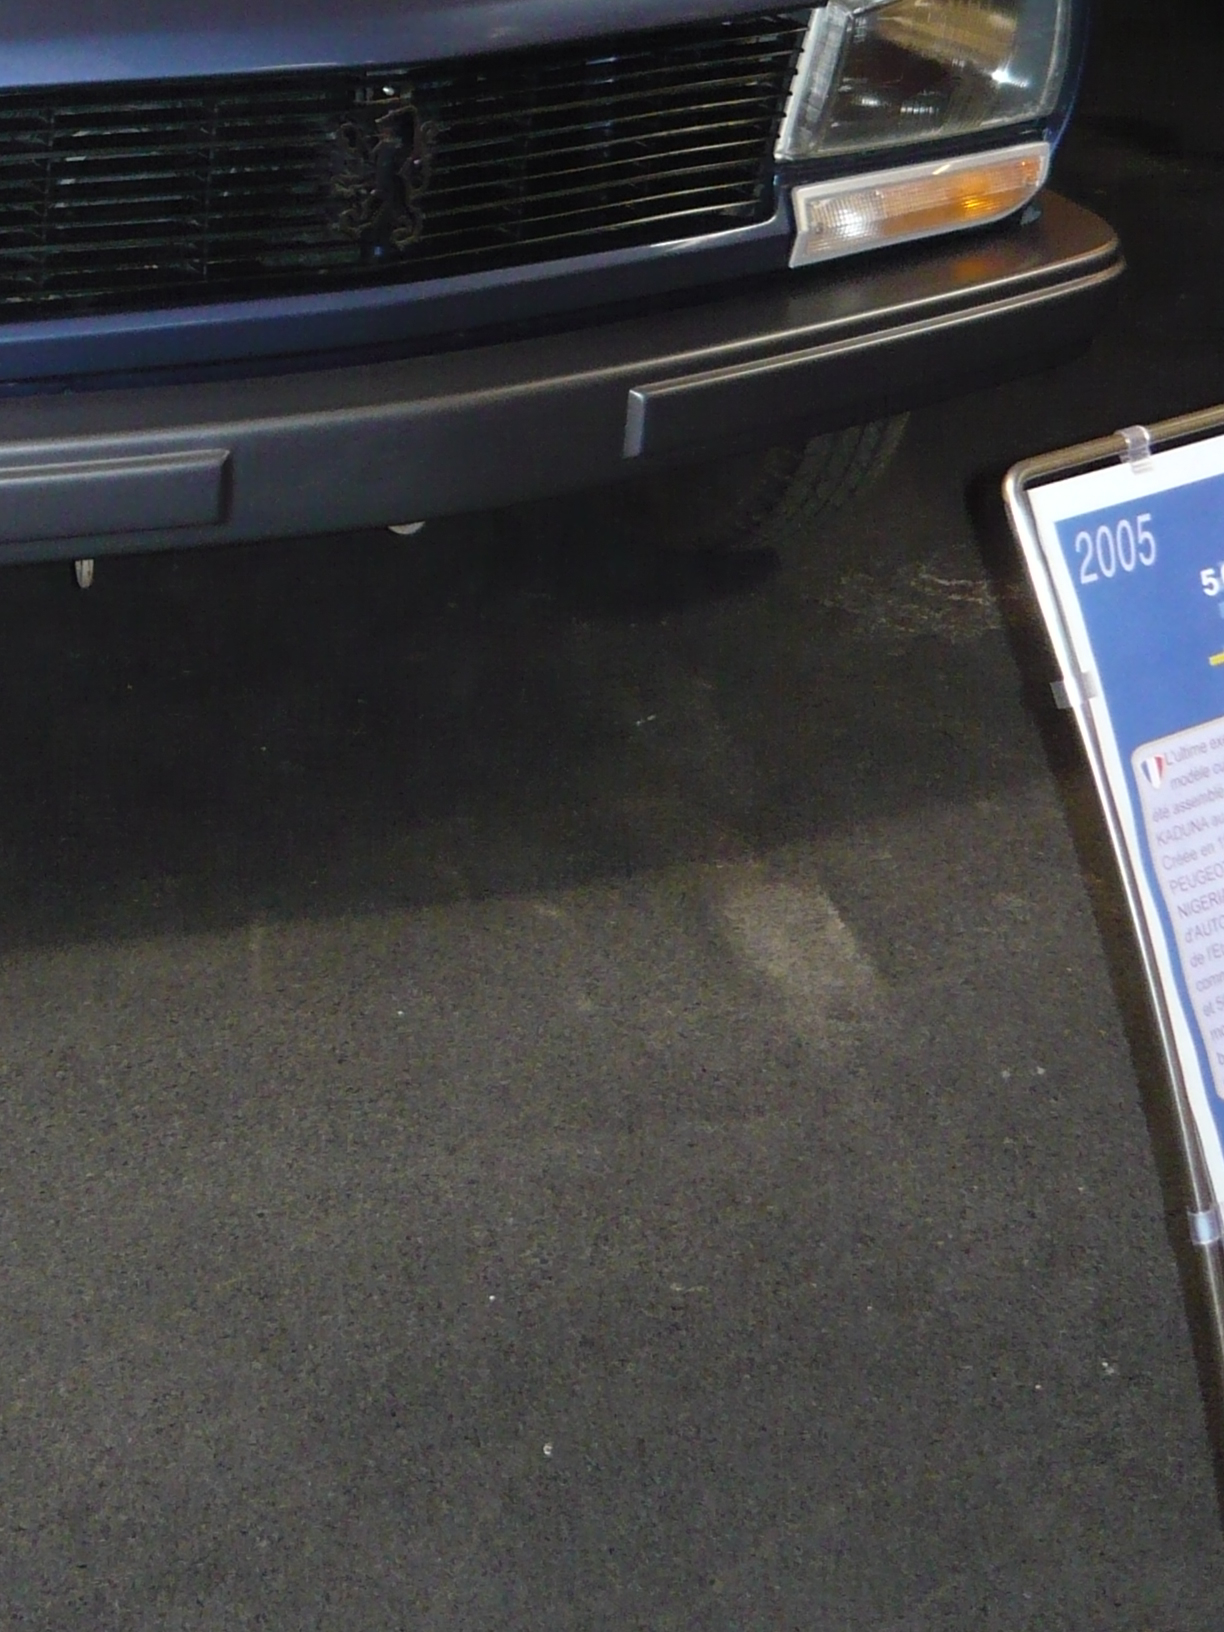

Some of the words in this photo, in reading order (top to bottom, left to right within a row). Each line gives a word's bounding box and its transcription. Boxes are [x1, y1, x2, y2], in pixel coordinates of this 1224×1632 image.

[1075, 512, 1156, 584] 2005
[1200, 560, 1224, 596] 5
[1156, 815, 1210, 846] KADUNA
[1200, 843, 1215, 858] en
[1168, 861, 1224, 895] PEUGEO
[1189, 952, 1205, 969] de
